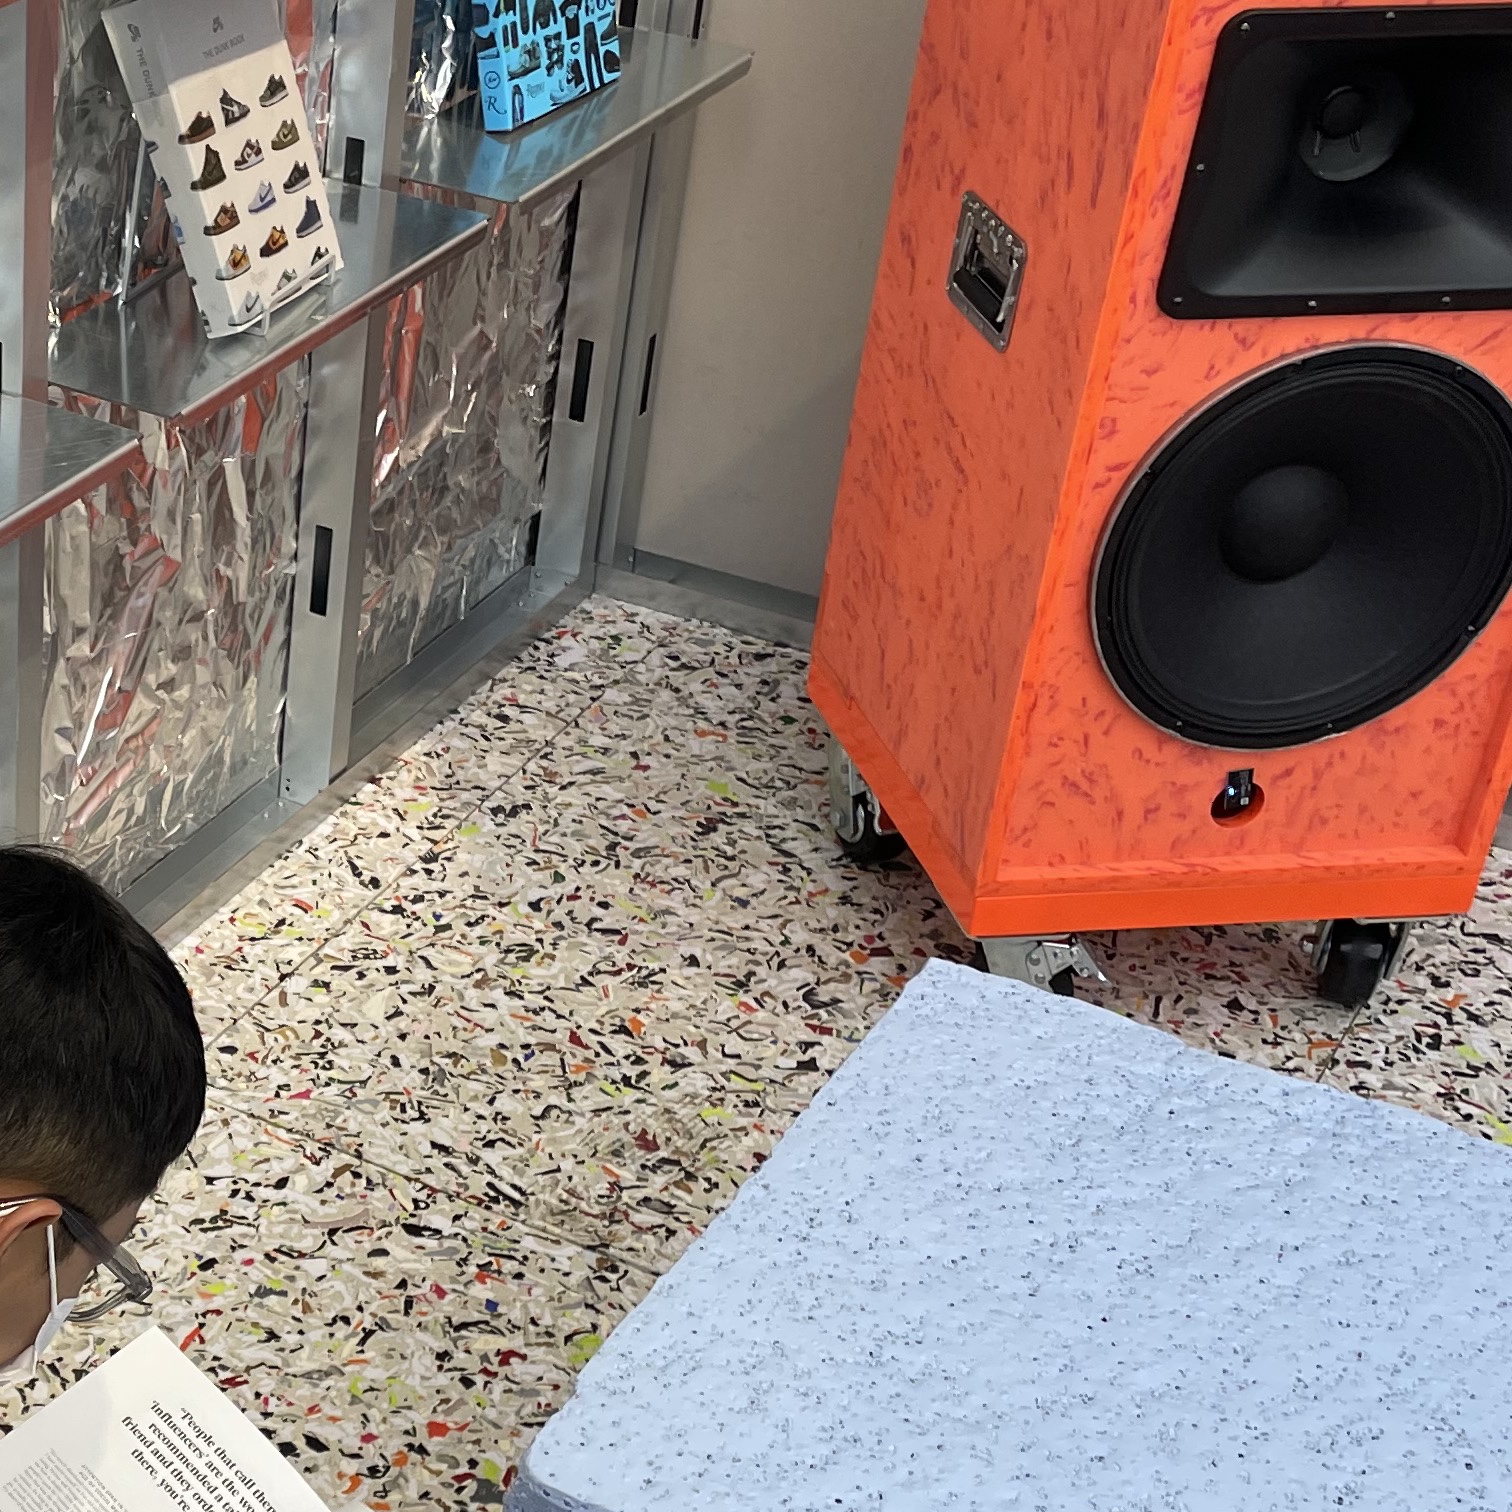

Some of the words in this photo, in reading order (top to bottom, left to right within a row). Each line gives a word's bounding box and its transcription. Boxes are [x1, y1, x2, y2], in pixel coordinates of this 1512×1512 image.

[121, 1416, 156, 1449] friend
[150, 1446, 175, 1470] and
[170, 1467, 194, 1492] they
[131, 1448, 158, 1480] there,
[157, 1477, 190, 1512] you're
[148, 1422, 219, 1495] recommended
[214, 1494, 223, 1503] a
[204, 1460, 224, 1479] are
[221, 1477, 240, 1497] the
[214, 1446, 237, 1470] that
[234, 1469, 257, 1490] call
